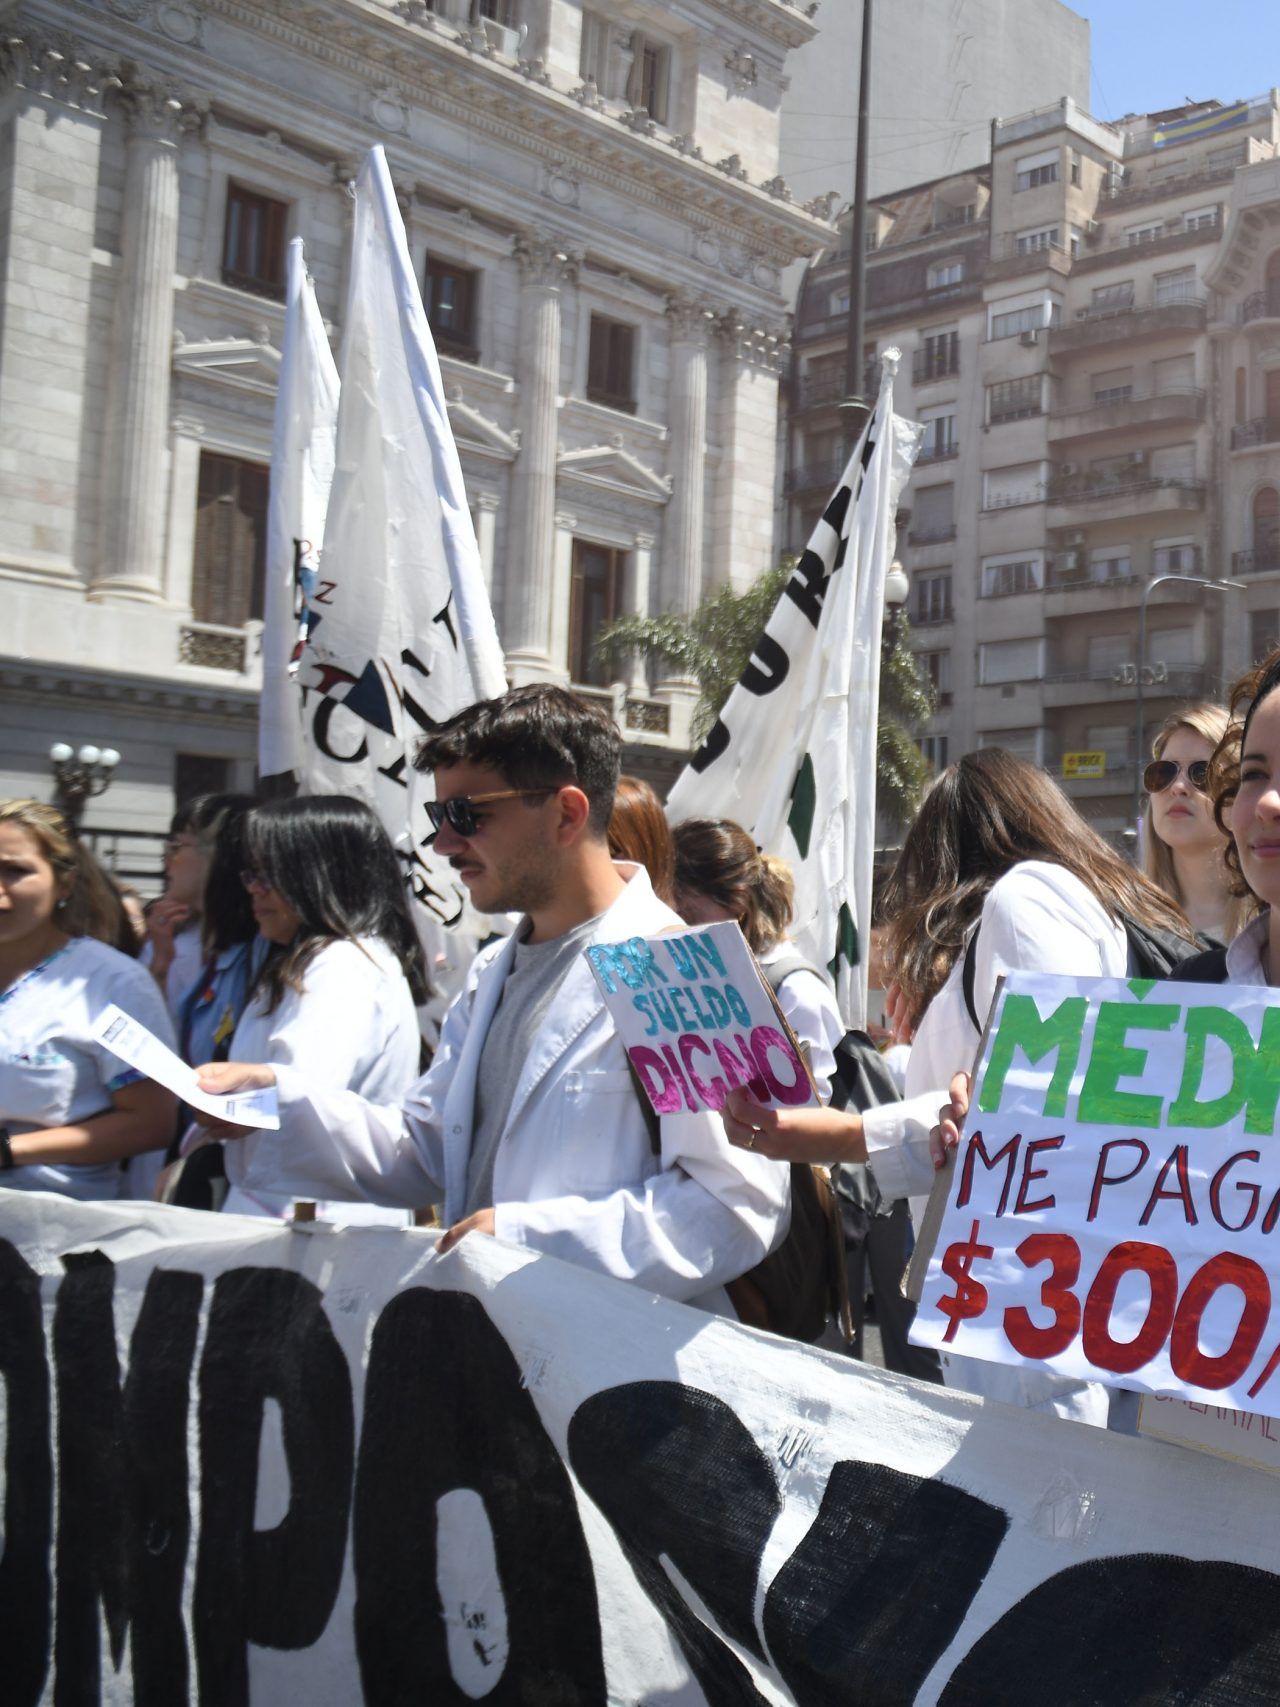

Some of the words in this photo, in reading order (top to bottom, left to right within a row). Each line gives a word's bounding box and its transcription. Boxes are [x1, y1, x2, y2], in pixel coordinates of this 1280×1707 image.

[587, 936, 669, 994] POR
[664, 933, 728, 981] UN
[631, 983, 751, 1037] SUELDO
[628, 1025, 813, 1114] DIGNO
[956, 1131, 1065, 1218] ME
